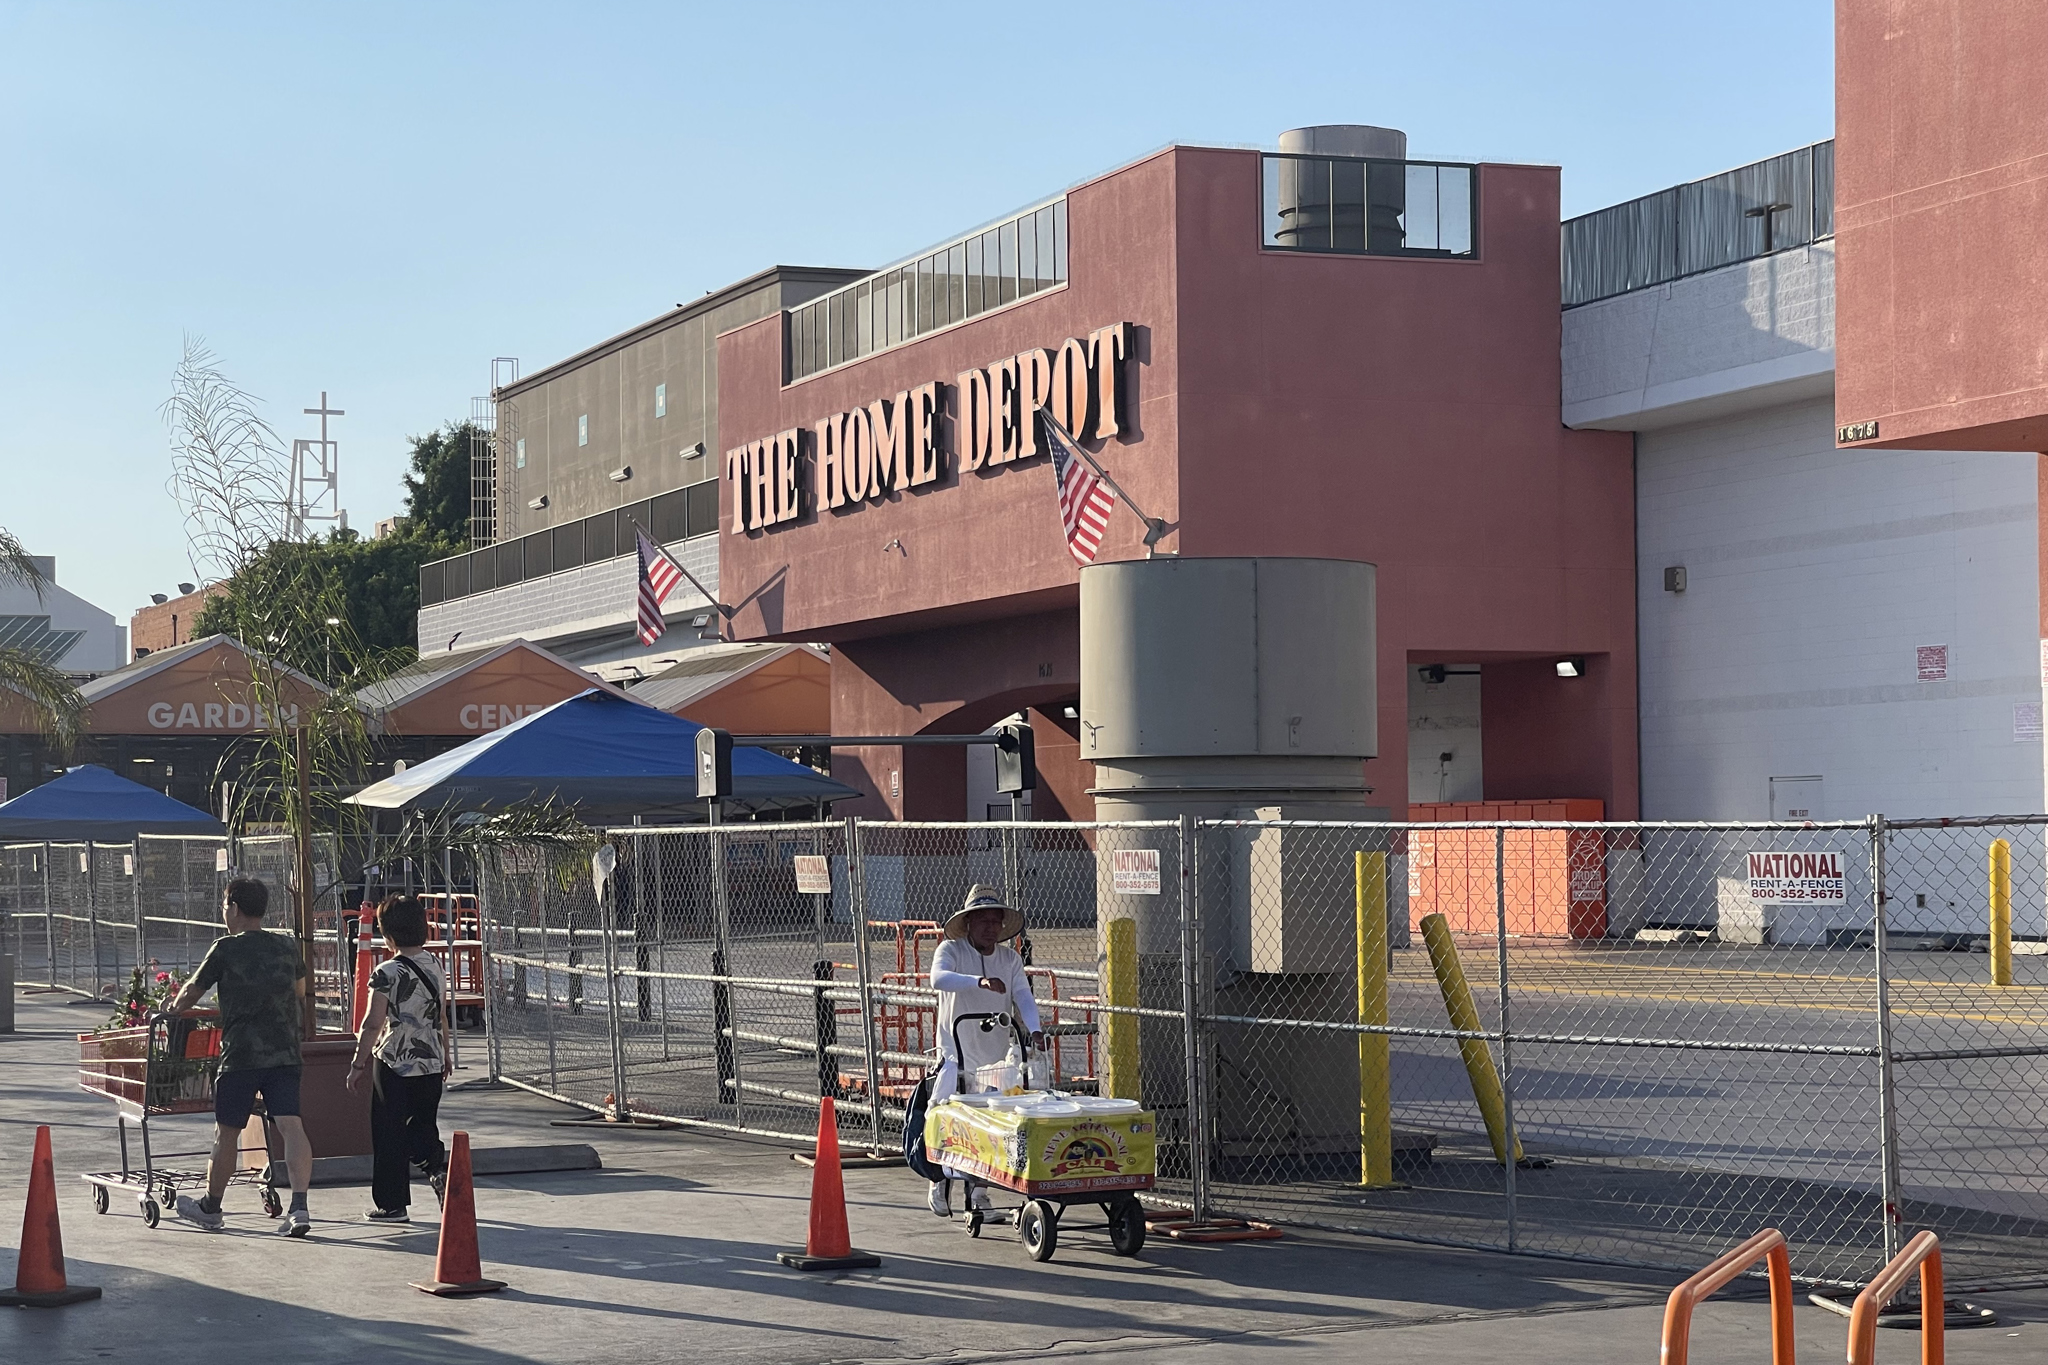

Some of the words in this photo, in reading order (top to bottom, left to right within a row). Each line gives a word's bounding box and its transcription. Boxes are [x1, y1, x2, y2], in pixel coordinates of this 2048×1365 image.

[726, 428, 799, 535] THE
[816, 381, 938, 513] HOME
[957, 322, 1127, 474] DEPOT
[1840, 423, 1873, 441] 1675
[147, 702, 298, 728] GARDEN
[460, 703, 546, 730] CENT
[796, 857, 828, 875] NATIONAL
[1114, 851, 1158, 872] NATIONAL
[1749, 854, 1842, 878] NATIONAL
[1572, 870, 1601, 880] ORDER
[1751, 880, 1843, 888] RENT-A-FENCE
[1116, 881, 1159, 889] 800-352-5675
[1573, 881, 1601, 890] PICKUP
[1751, 889, 1843, 899] 800-352-5675
[1043, 1129, 1069, 1164] NIEVE
[1071, 1121, 1128, 1158] ARTESANAL
[1065, 1159, 1106, 1169] CALI
